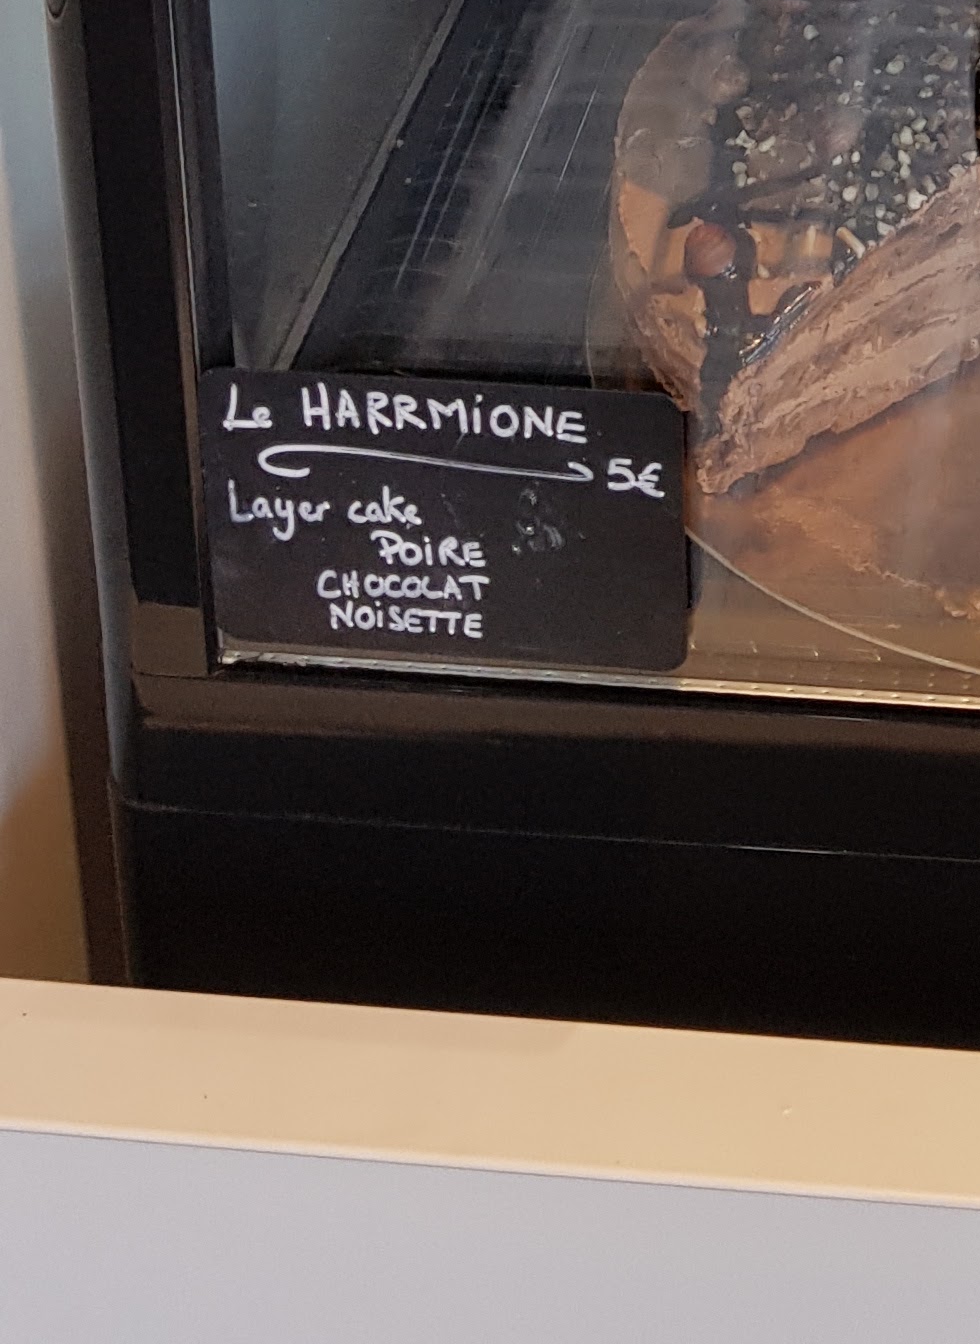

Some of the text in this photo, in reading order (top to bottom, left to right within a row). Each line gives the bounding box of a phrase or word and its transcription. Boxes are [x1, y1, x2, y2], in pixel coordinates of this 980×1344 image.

[223, 384, 272, 431] Le
[608, 458, 665, 497] 5€
[228, 480, 422, 541] Layer cake
[318, 570, 489, 600] CHOCOLAT
